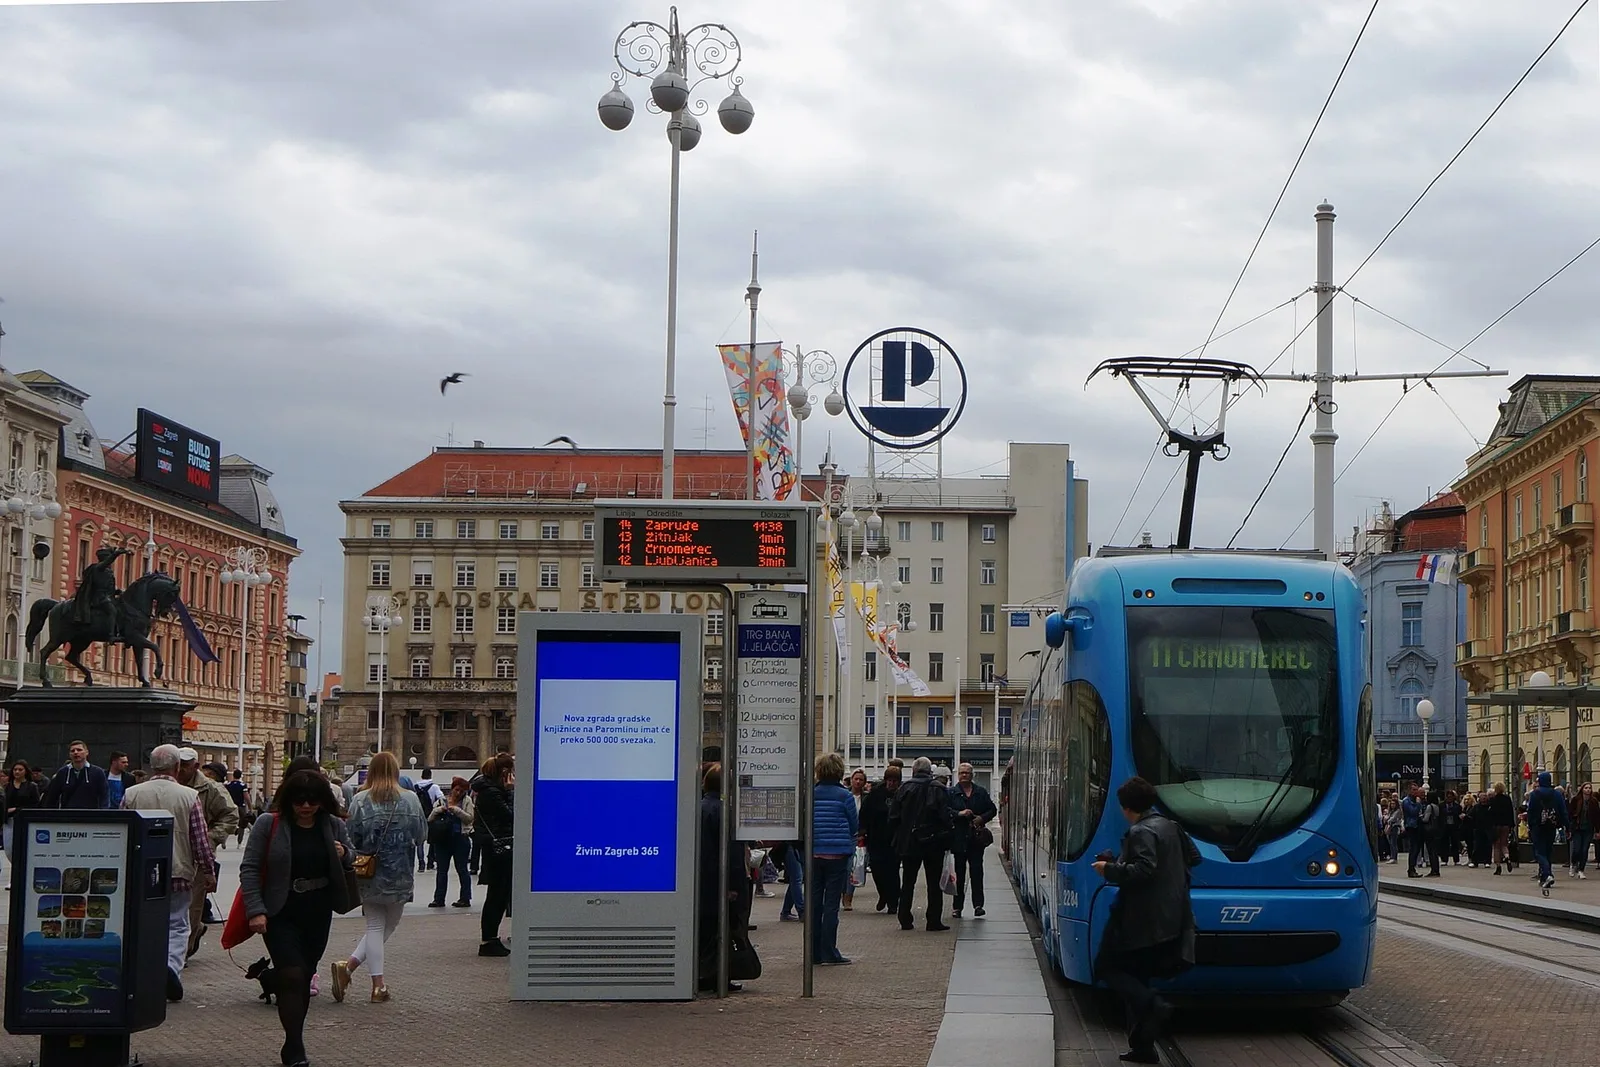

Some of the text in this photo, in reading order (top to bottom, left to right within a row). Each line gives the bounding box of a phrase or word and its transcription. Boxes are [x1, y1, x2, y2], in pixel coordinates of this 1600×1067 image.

[187, 453, 211, 472] FUTURE
[616, 509, 636, 518] Linija
[646, 509, 683, 517] Odredište
[760, 511, 791, 519] Dolazak
[618, 519, 632, 530] 14
[752, 521, 783, 532] 11:38
[618, 531, 784, 543] 13 Žitnjak 1min
[618, 543, 786, 556] 11 Črnomerec 3min
[618, 555, 786, 567] 12 Ljubljanica 3min
[392, 591, 536, 609] GRADSKA
[746, 629, 792, 640] TRG BANA
[742, 642, 749, 652] J.
[744, 661, 749, 672] 1
[738, 694, 797, 704] 11 Črnomerec
[587, 715, 616, 724] zgrada
[617, 715, 651, 724] gradske
[741, 711, 796, 722] 12 Ljubljanica
[544, 725, 581, 734] knjižnice
[595, 725, 638, 733] Paromlinu
[661, 726, 671, 734] će
[738, 728, 777, 739] 13 Žitnjak
[560, 736, 656, 745] preko 500 000 svezaka.
[738, 745, 748, 755] 14
[738, 762, 778, 772] 17 Prečko
[56, 831, 88, 839] BRIJUNI
[575, 844, 659, 858] Živim Zagreb 365
[1221, 906, 1263, 923] ZET
